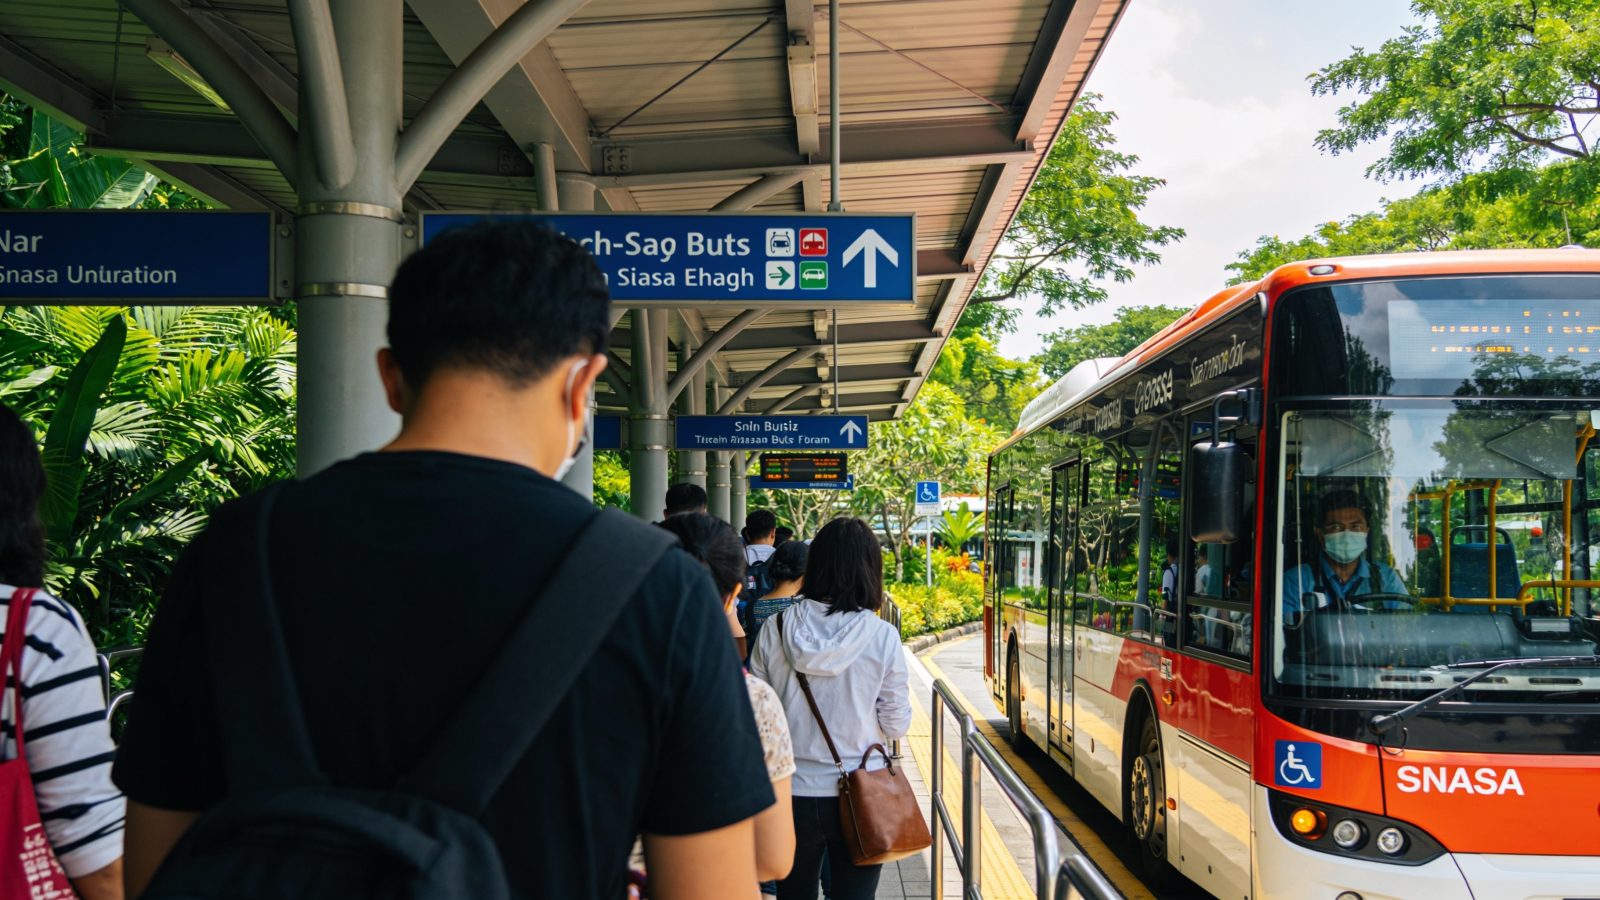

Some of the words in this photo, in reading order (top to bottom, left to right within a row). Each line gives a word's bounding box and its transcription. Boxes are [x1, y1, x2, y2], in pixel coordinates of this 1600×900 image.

[687, 232, 751, 256] Buts
[617, 267, 675, 287] Siasa
[685, 267, 754, 292] Ehagh
[1396, 765, 1525, 796] SNASA
